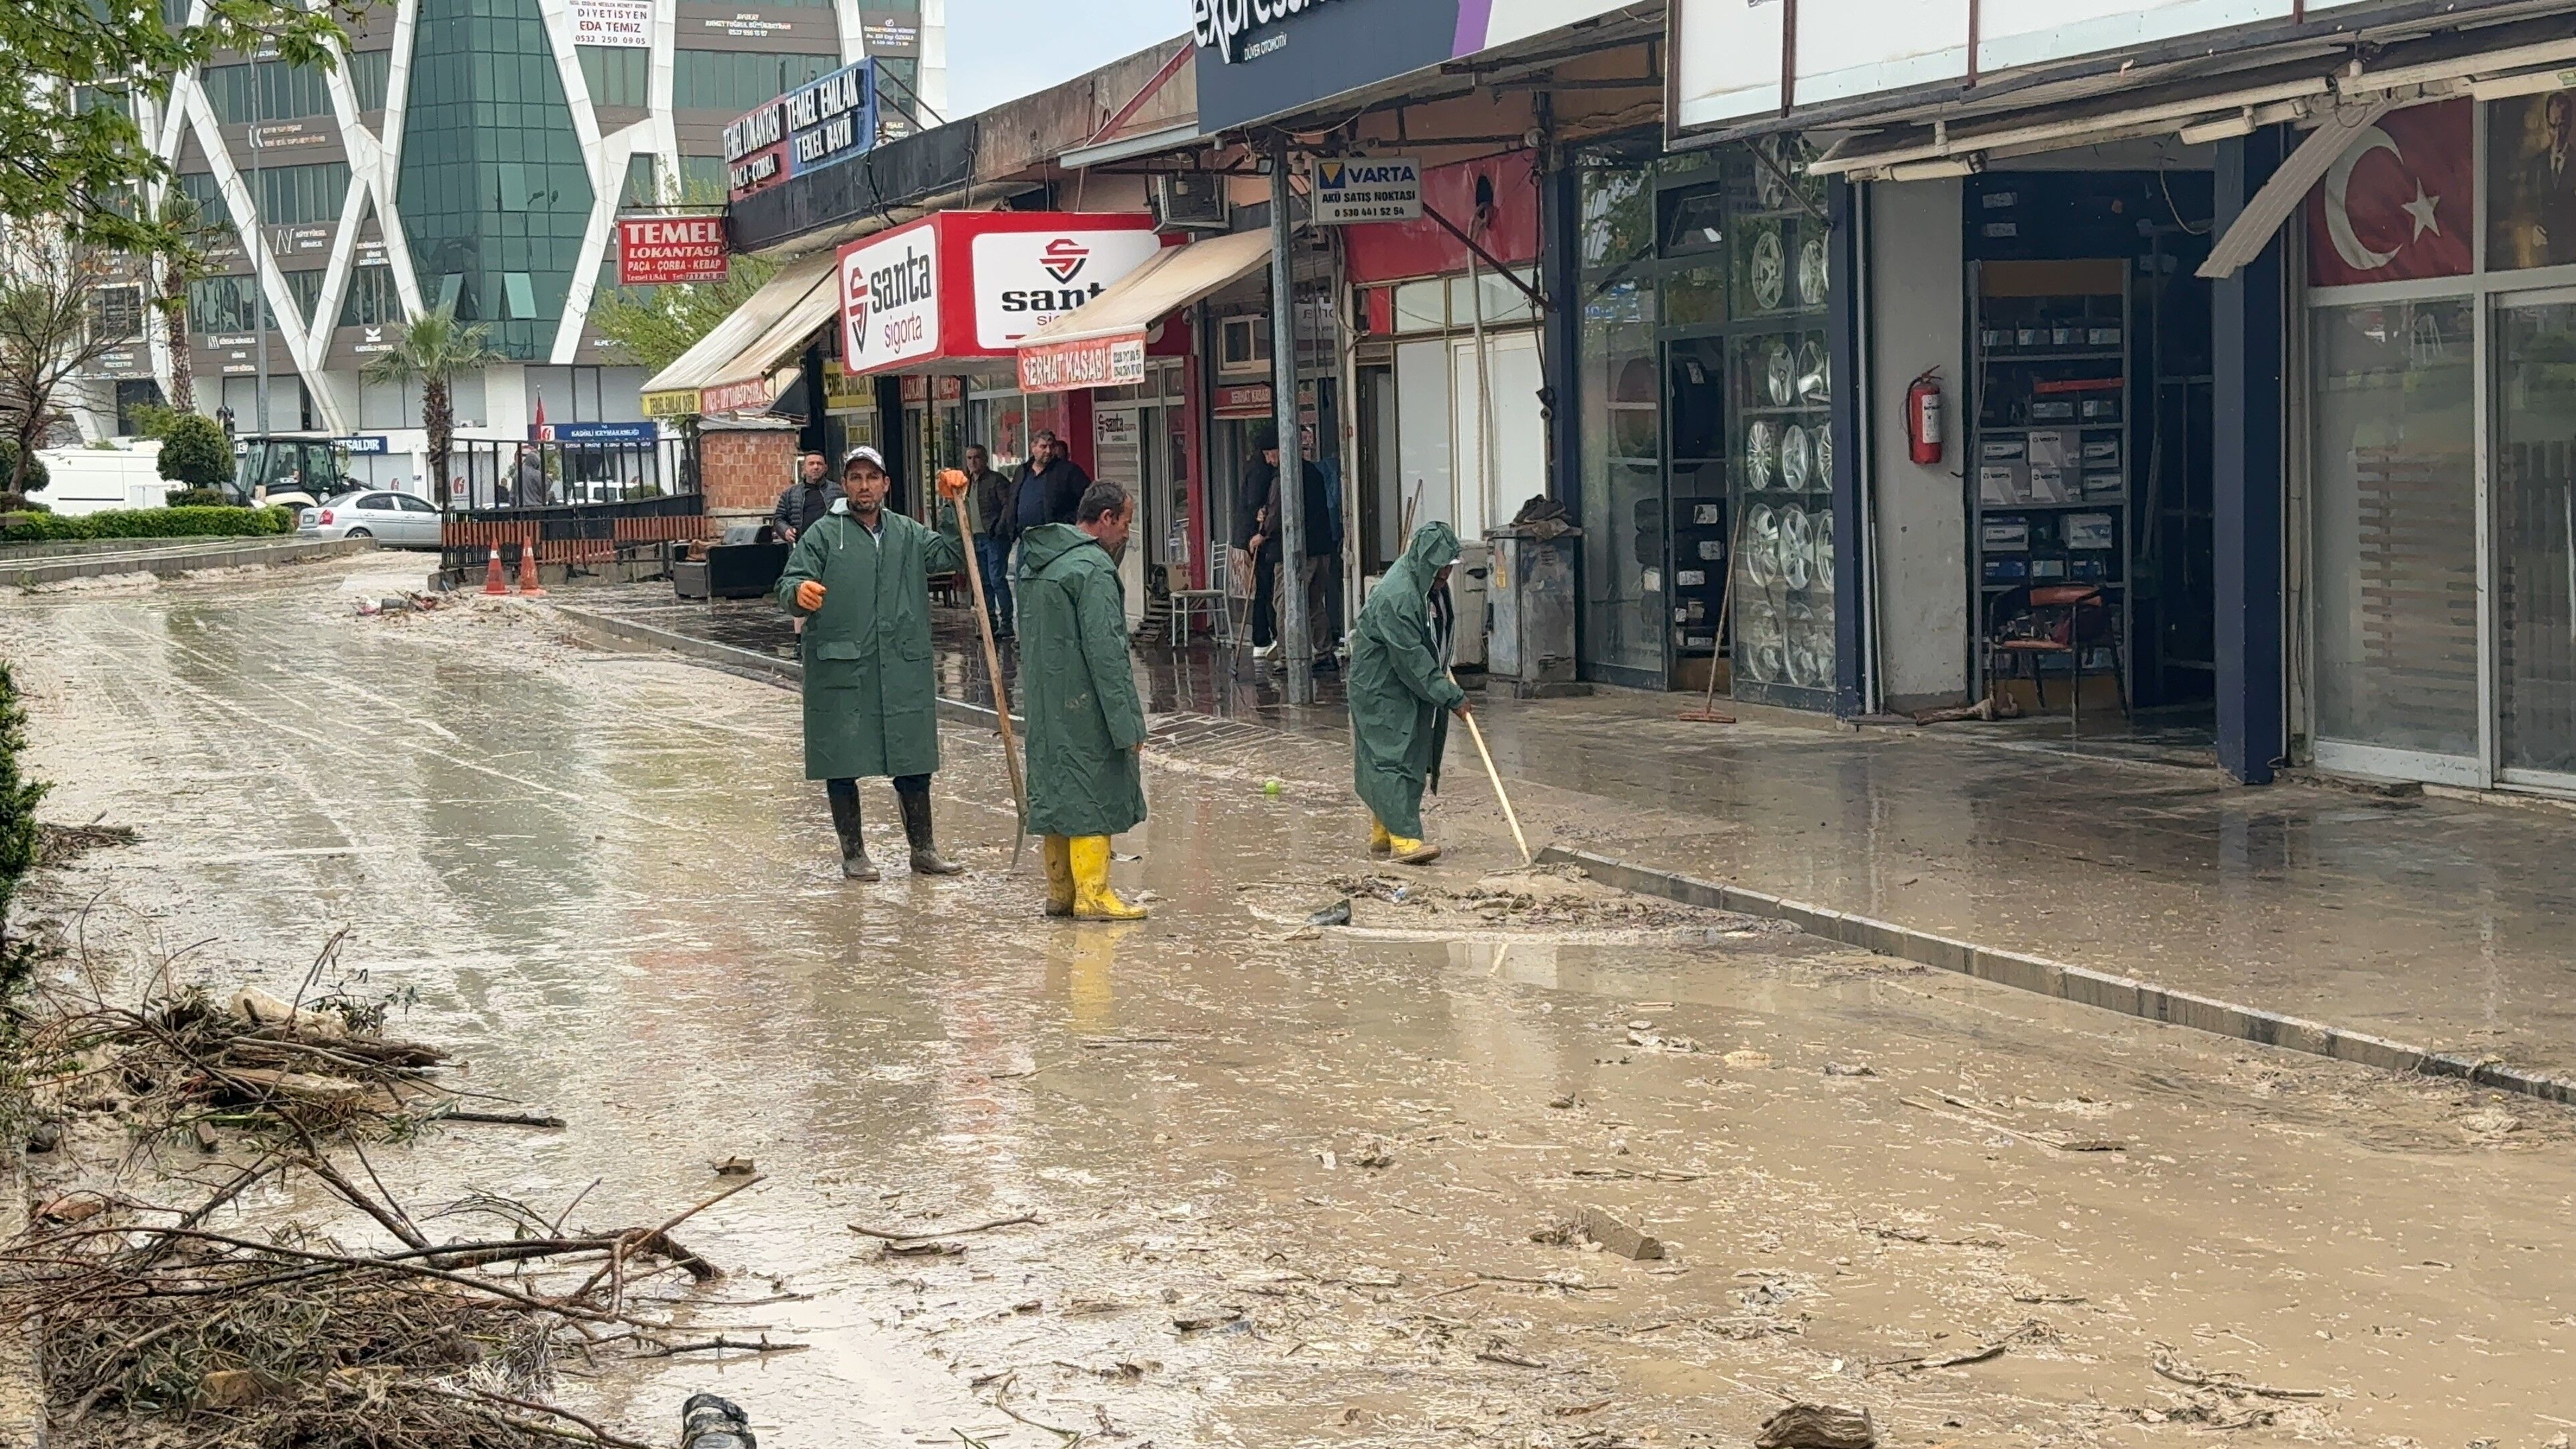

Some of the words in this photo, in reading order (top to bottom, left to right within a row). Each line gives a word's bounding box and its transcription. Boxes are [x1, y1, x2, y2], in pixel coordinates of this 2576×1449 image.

[580, 21, 602, 31] EDA
[606, 22, 641, 33] TEMİZ
[1260, 32, 1287, 53] OTOMOTİV
[786, 88, 818, 133] TEMEL
[820, 68, 859, 119] EMLAK
[723, 122, 743, 164] TEMEL
[741, 103, 781, 154] LOKANTASI
[795, 129, 824, 163] TEKEL
[1348, 166, 1415, 183] VARTA
[1322, 191, 1340, 203] AKÜ
[1344, 192, 1371, 203] SATIŞ
[1374, 191, 1415, 201] NOKTASI
[625, 222, 722, 244] TEMEL
[629, 246, 720, 259] LOKANTASI
[627, 261, 651, 274] PAÇA
[657, 260, 686, 274] ÇORBA
[692, 259, 721, 269] KEBAP
[871, 246, 932, 314] santa
[1002, 282, 1107, 311] sant
[884, 311, 922, 354] sigorta
[1022, 353, 1063, 386] SERHAT
[1065, 347, 1106, 382] KASABI
[1106, 413, 1123, 432] santa
